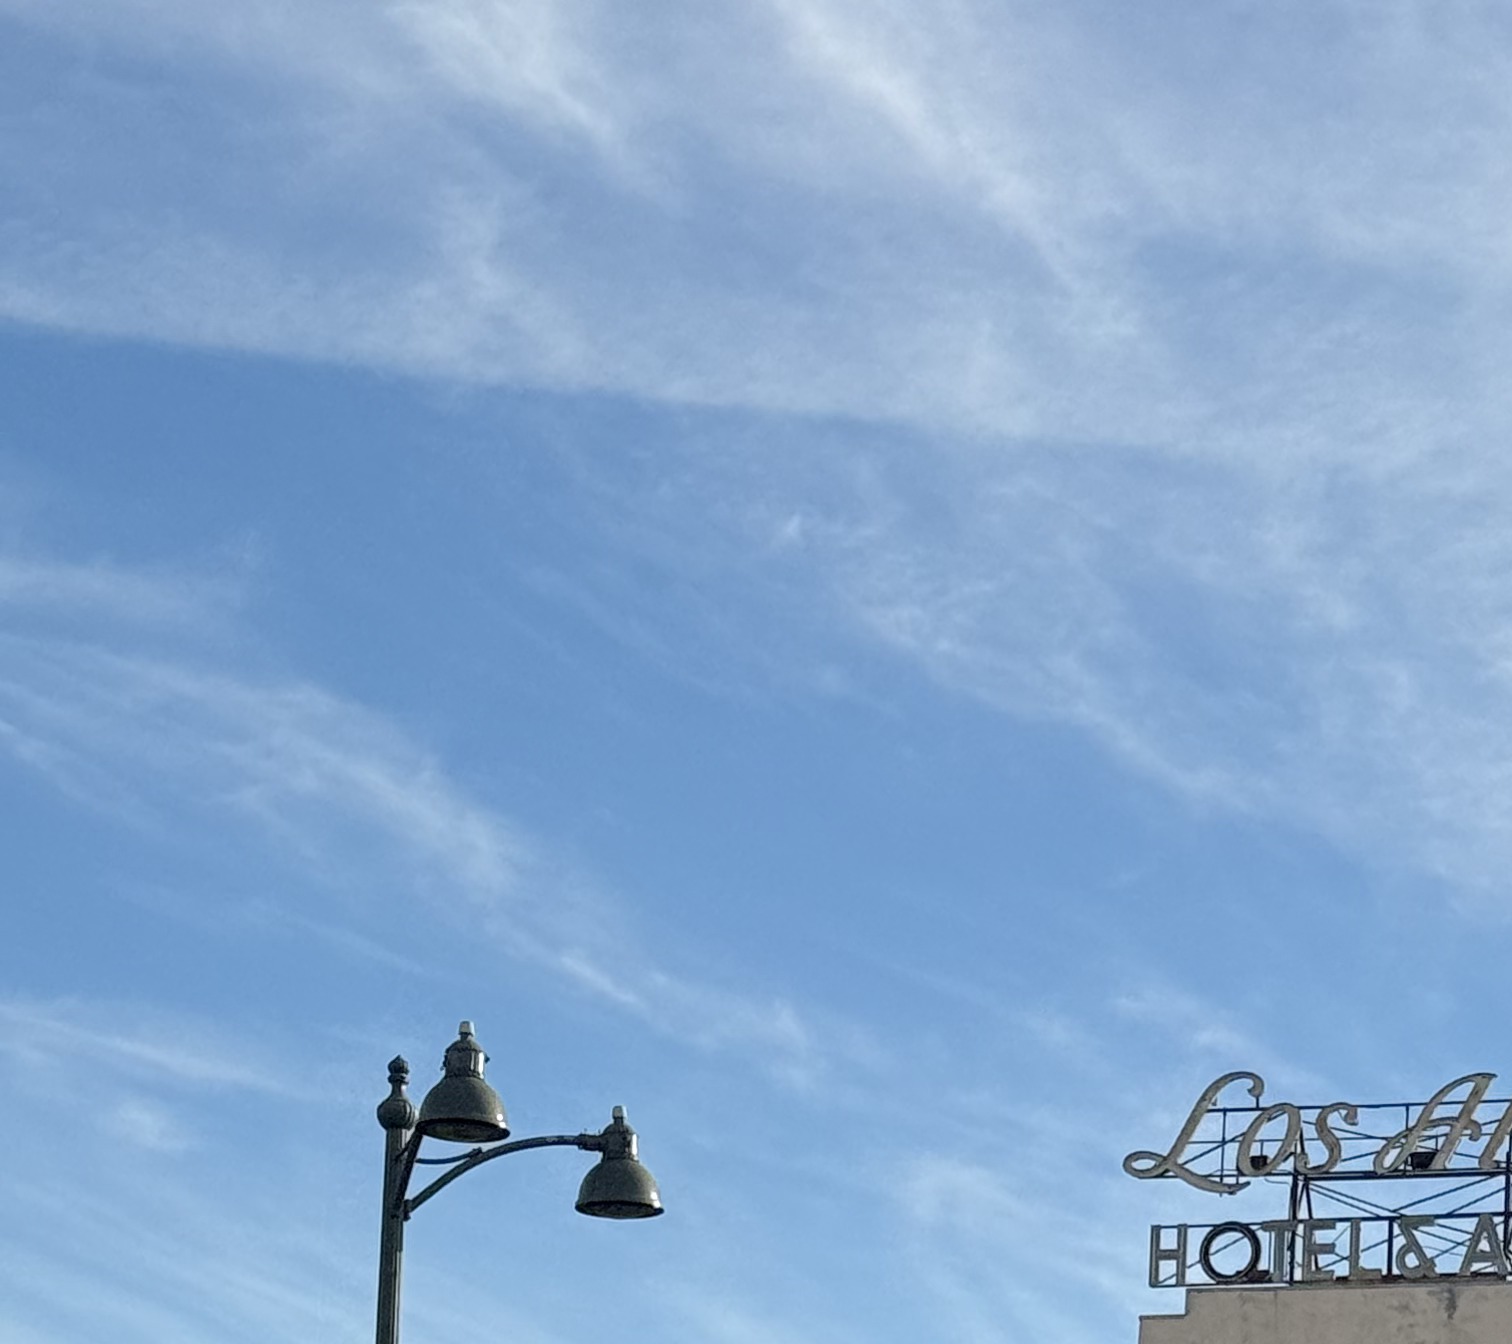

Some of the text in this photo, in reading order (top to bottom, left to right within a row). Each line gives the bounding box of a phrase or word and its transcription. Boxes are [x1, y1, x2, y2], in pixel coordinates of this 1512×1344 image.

[1123, 1071, 1358, 1194] Los
[1151, 1219, 1382, 1285] HOTEL
[1396, 1215, 1438, 1279] &
